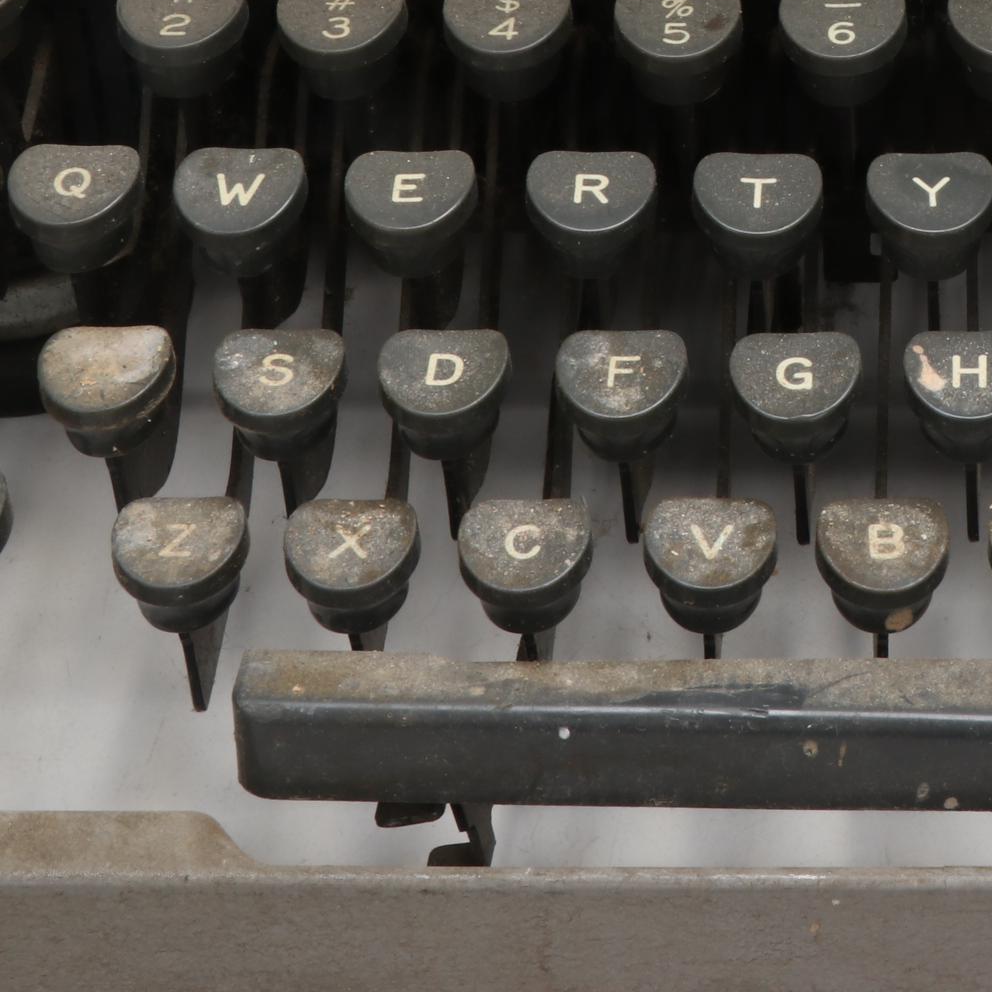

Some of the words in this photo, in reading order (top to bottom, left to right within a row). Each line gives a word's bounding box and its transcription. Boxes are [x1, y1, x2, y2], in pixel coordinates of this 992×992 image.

[160, 14, 191, 36] 2
[321, 17, 350, 39] 3
[488, 17, 518, 40] 4
[662, 22, 690, 44] 5
[828, 22, 855, 44] 6
[54, 168, 92, 197] Q
[217, 173, 266, 206] W
[393, 173, 425, 202] E
[573, 174, 609, 204] R
[741, 177, 777, 208] T
[912, 176, 951, 208] Y
[259, 354, 294, 385] S
[425, 354, 463, 386] D
[606, 355, 641, 387] F
[776, 357, 813, 390] G
[952, 355, 988, 388] H
[159, 523, 196, 557] Z
[328, 524, 368, 559] X
[504, 524, 541, 559] C
[691, 524, 734, 559] V
[868, 523, 904, 559] B
